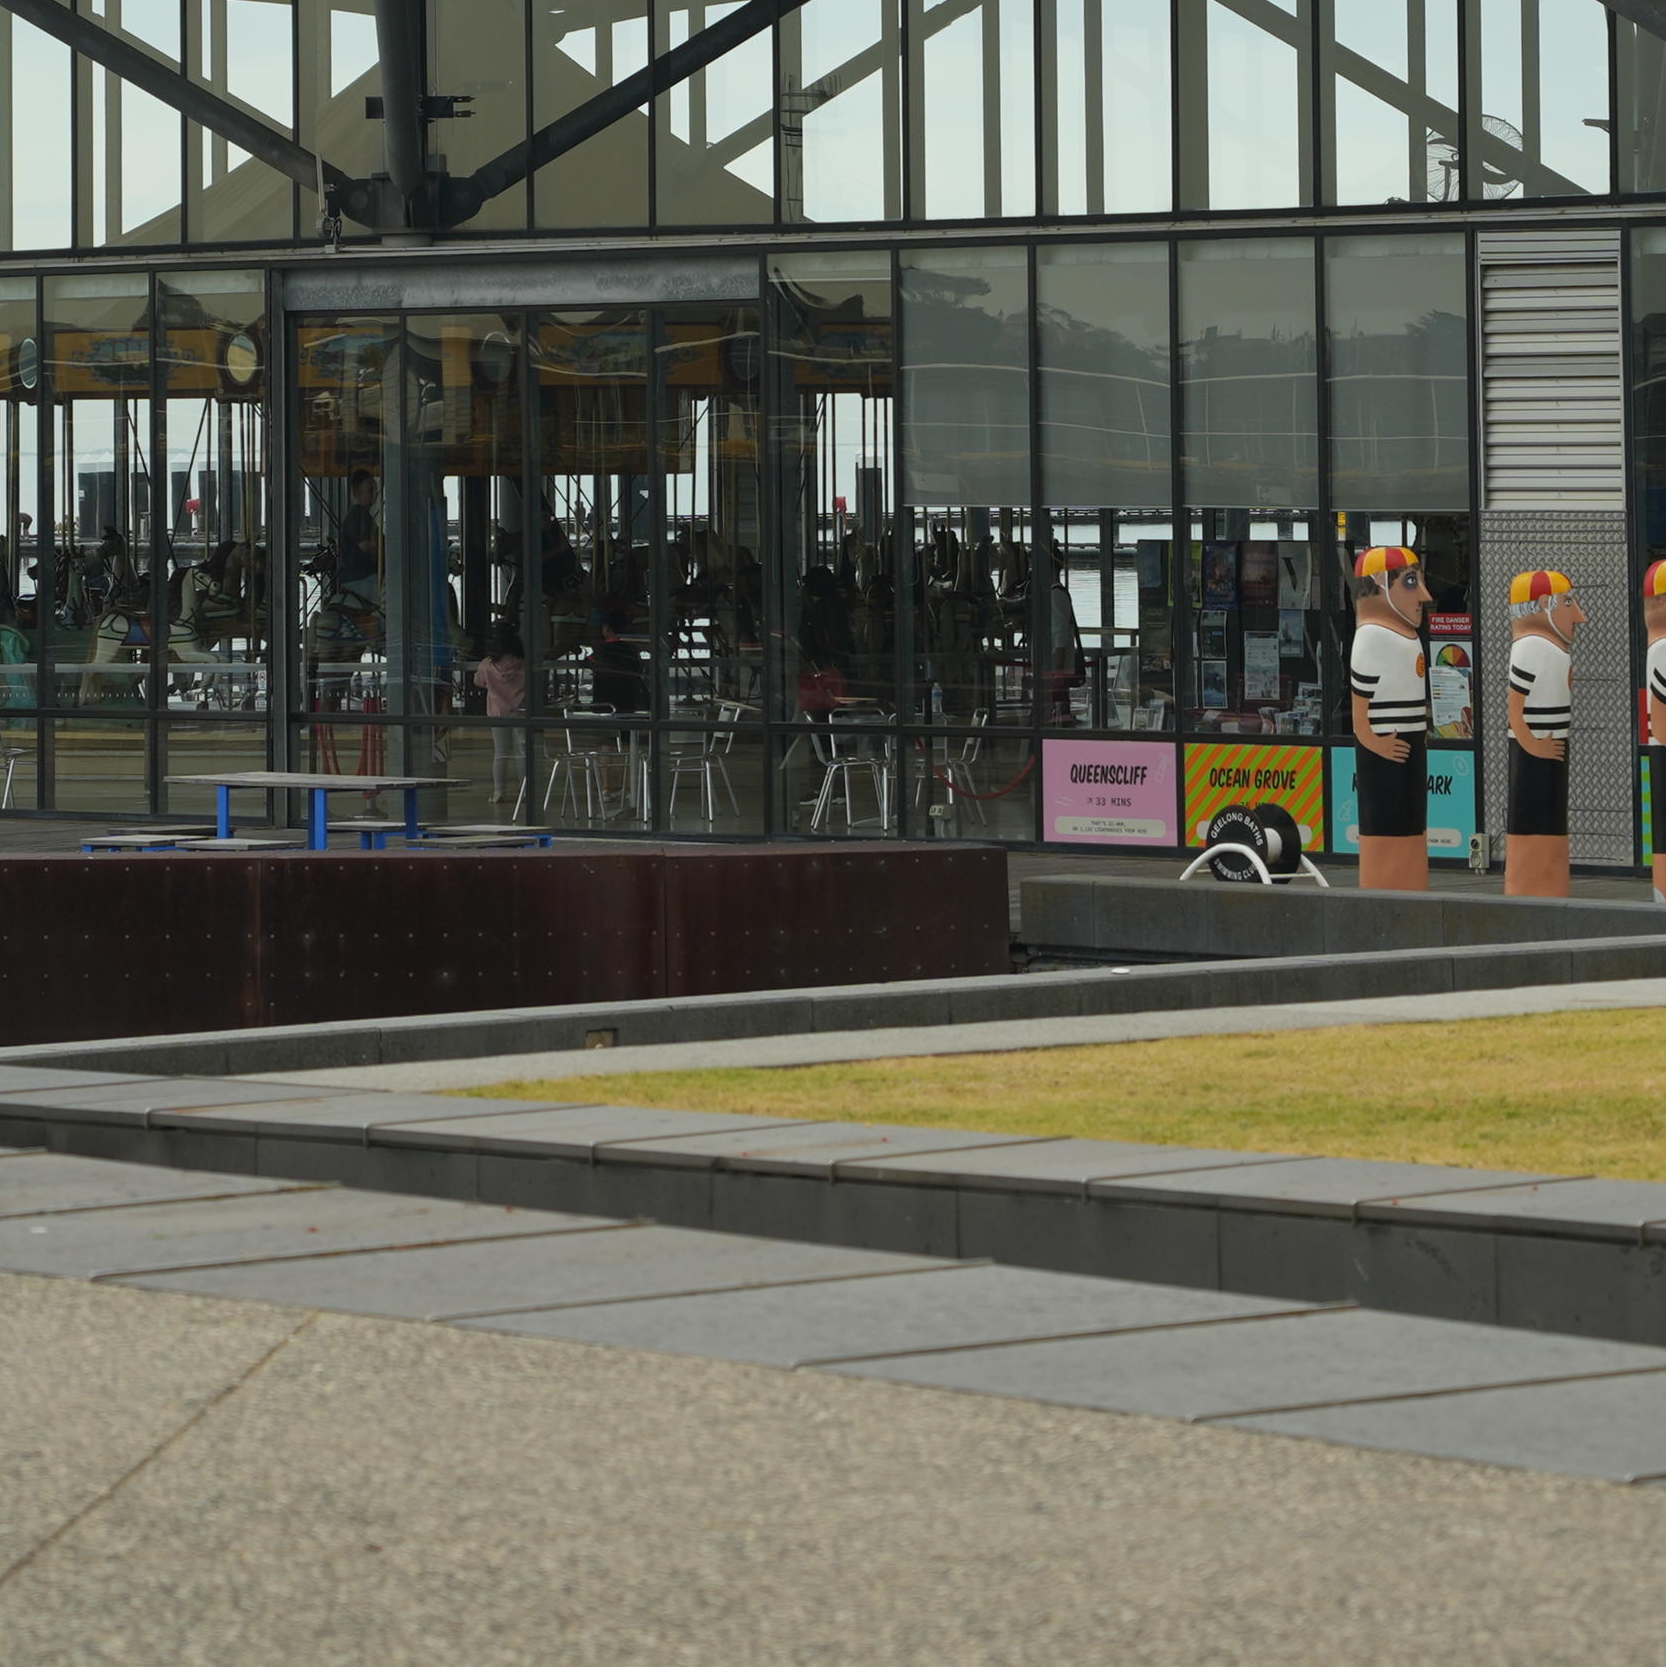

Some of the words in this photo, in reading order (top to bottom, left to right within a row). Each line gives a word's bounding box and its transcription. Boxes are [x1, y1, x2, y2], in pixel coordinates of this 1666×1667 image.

[1070, 764, 1148, 786] QUEENSCLIFF
[1209, 767, 1251, 789] OCEAN
[1254, 768, 1297, 790] GROVE
[1427, 774, 1453, 795] ARK
[1095, 797, 1107, 807] 33
[1110, 797, 1133, 807] MINS
[1210, 811, 1244, 839] GEELONG
[1244, 815, 1264, 847] BATHS
